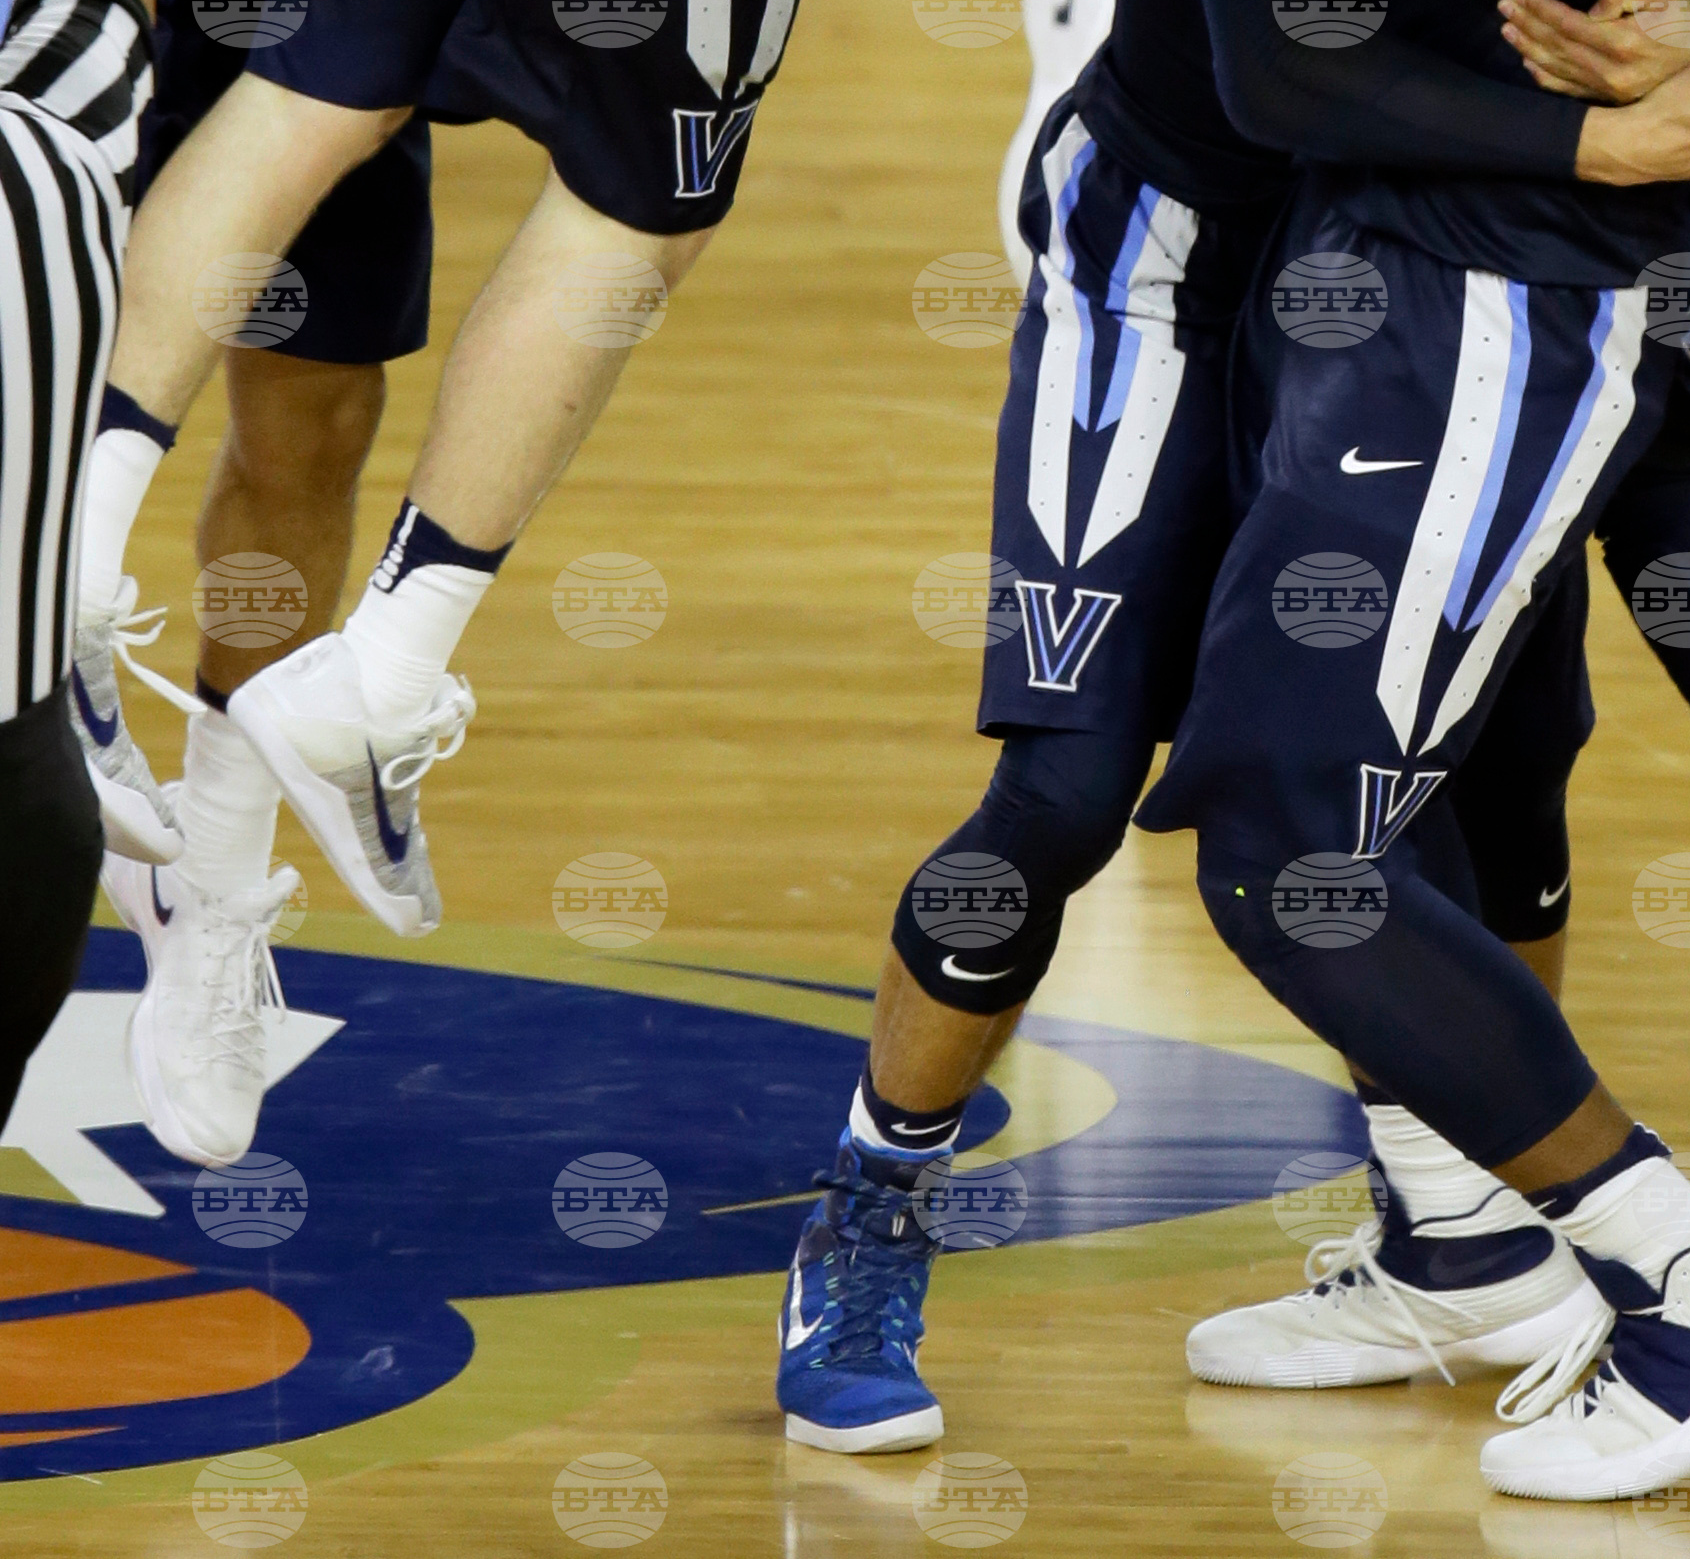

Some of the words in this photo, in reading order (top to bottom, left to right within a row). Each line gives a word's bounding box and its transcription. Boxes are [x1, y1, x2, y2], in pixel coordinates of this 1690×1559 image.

[673, 99, 760, 198] V
[1015, 580, 1122, 692] V
[1352, 763, 1448, 859] V
